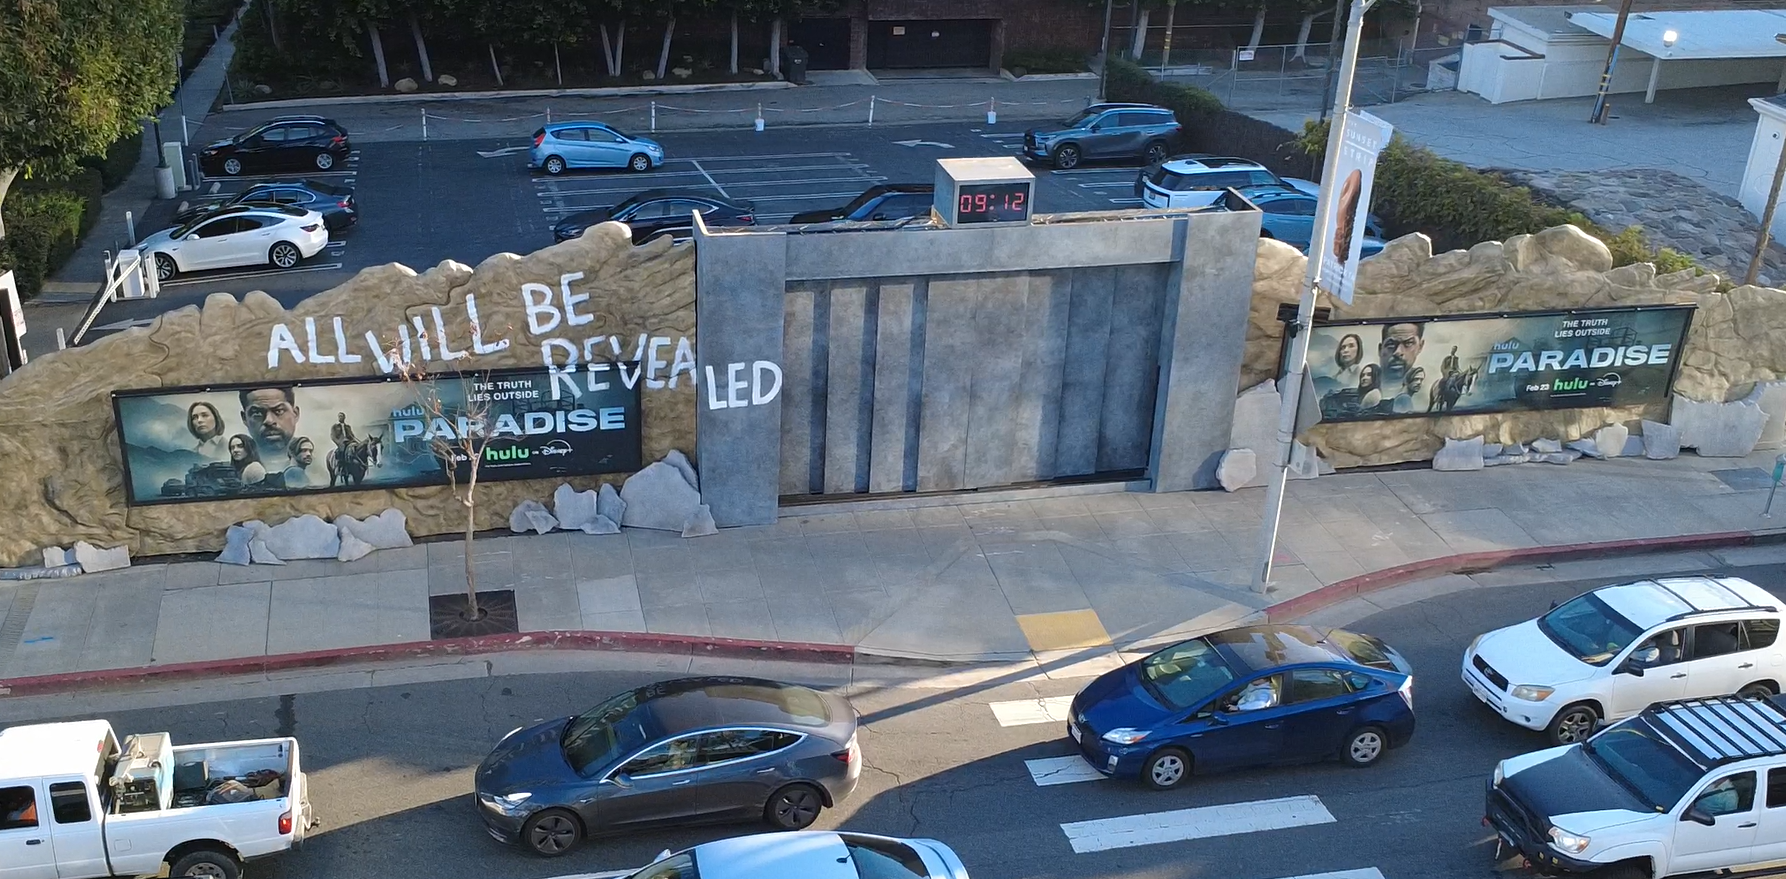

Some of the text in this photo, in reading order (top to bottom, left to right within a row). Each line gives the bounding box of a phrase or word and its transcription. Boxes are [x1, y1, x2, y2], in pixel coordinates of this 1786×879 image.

[960, 193, 1024, 213] 09:12
[267, 271, 594, 374] ALL WILL BE
[1563, 318, 1608, 328] THE TRUTH
[1554, 327, 1611, 338] LIES OUTSIDE
[1494, 341, 1520, 350] hulu
[1488, 343, 1672, 374] PARADISE
[473, 380, 532, 391] THE TRUTH
[1526, 384, 1539, 392] Feb
[1540, 383, 1550, 391] 23
[1553, 377, 1589, 391] hulu
[468, 390, 539, 402] LIES OUTSIDE
[392, 406, 425, 417] hulu
[393, 406, 625, 443] PARADISE
[486, 445, 530, 461] hulu
